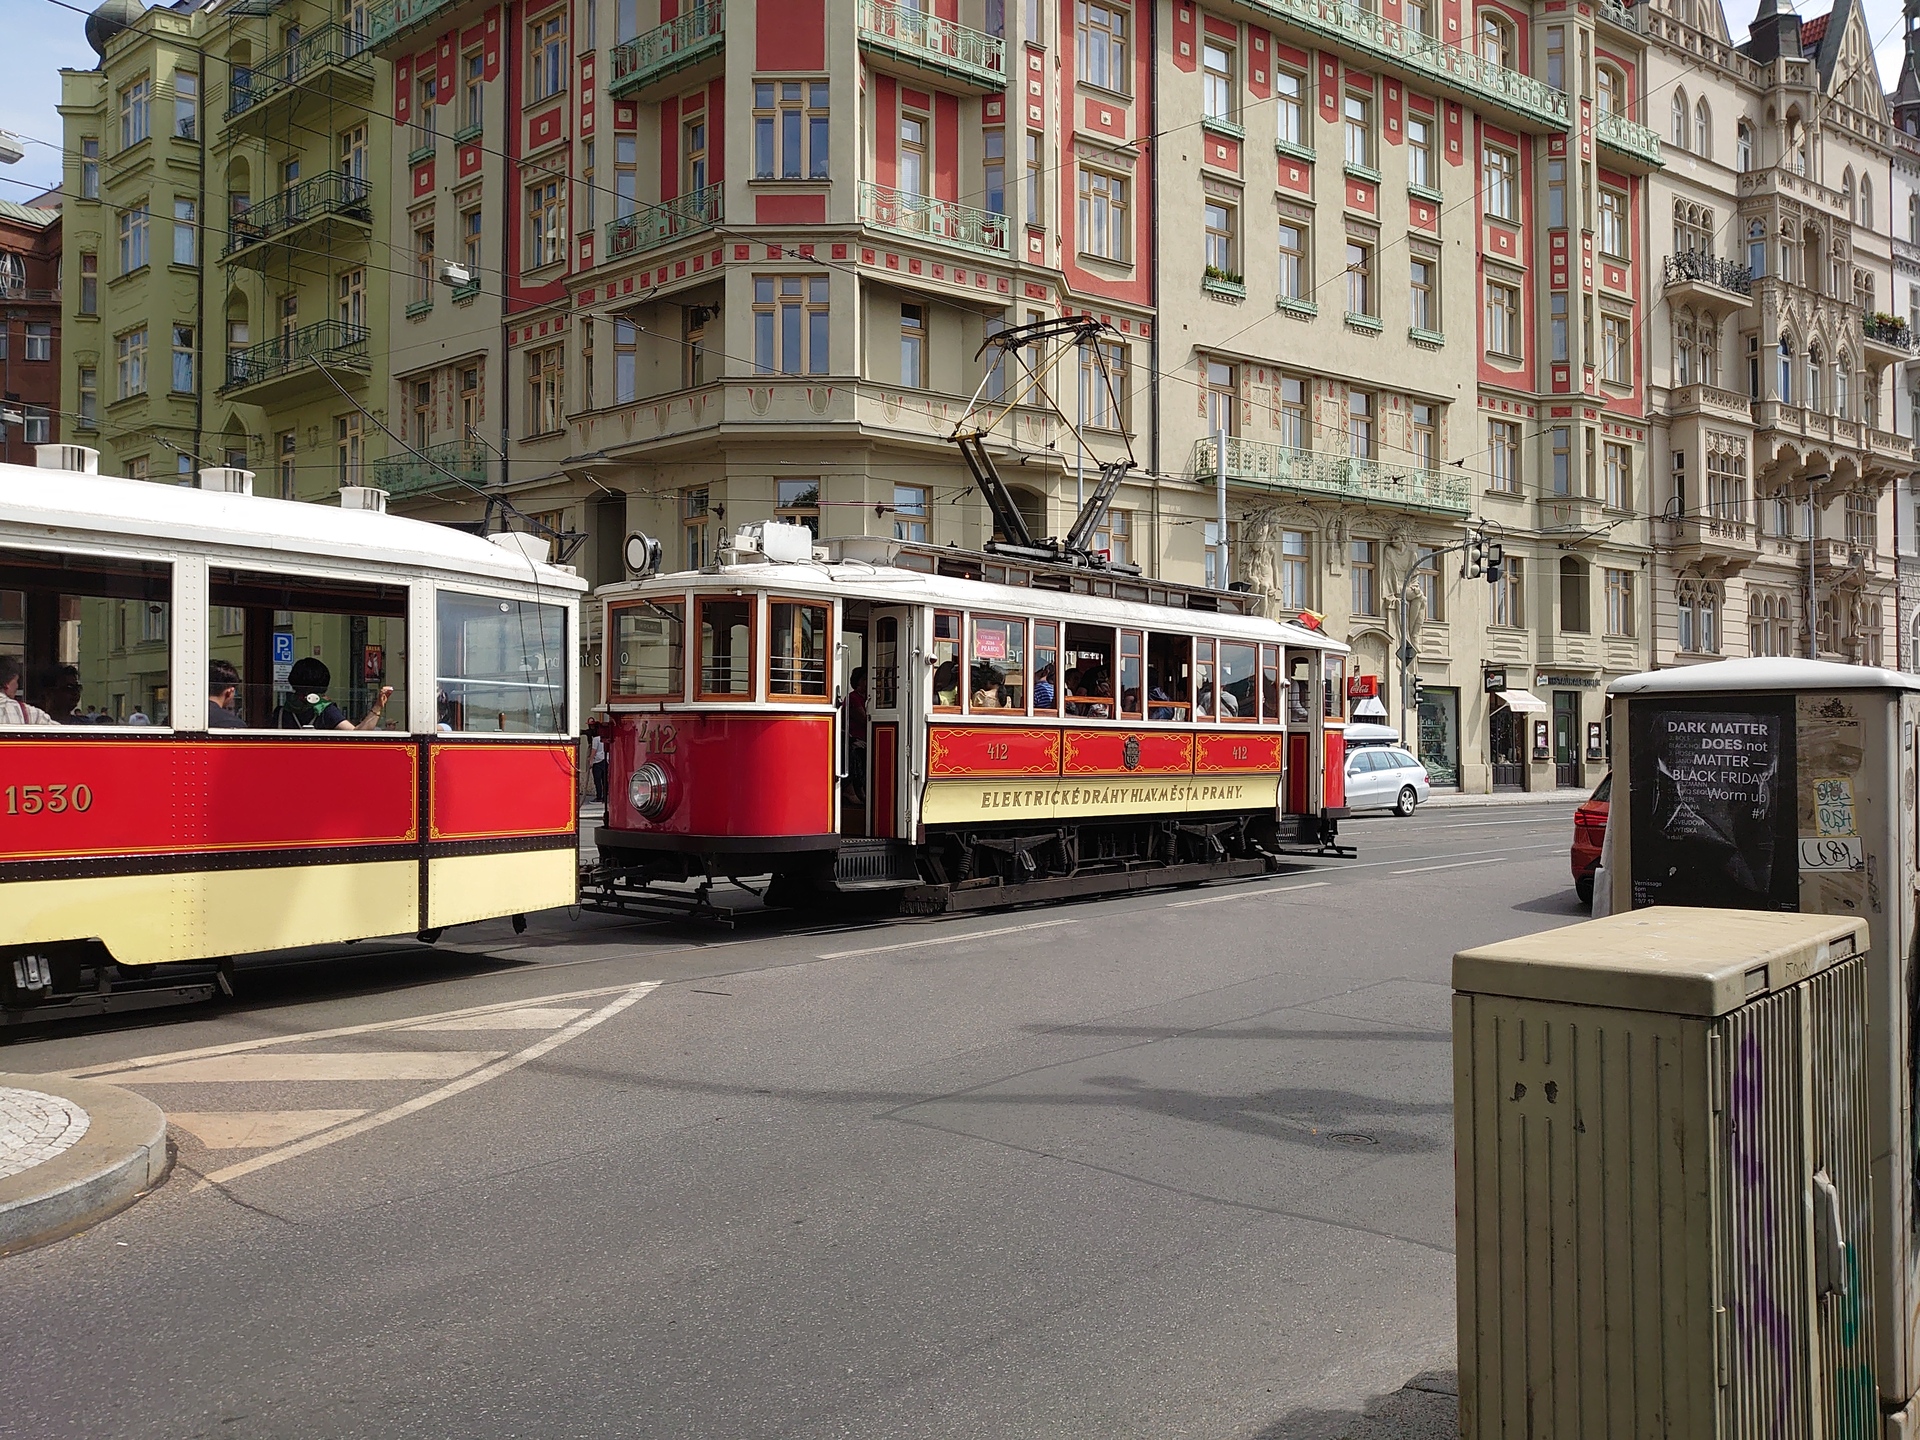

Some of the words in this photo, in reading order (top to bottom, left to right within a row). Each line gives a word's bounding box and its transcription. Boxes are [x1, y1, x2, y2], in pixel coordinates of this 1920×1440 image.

[277, 637, 289, 653] P
[1667, 721, 1707, 733] DARK
[1709, 722, 1768, 736] MATTER
[638, 723, 677, 754] 412
[1701, 738, 1743, 750] DOES
[1746, 742, 1768, 752] not
[987, 743, 1009, 760] 412
[1232, 746, 1248, 760] 412
[1693, 754, 1750, 768] MATTER
[1672, 769, 1717, 783] BLACK
[1721, 771, 1768, 785] FRIDAY
[5, 783, 93, 815] 1530
[980, 787, 1080, 808] ELEKTRICKÉ
[1081, 787, 1129, 804] DRÁHY
[1202, 785, 1243, 800] PRAHY.
[1707, 787, 1747, 801] Worm
[1751, 793, 1767, 805] up
[1751, 808, 1766, 820] #1
[1634, 880, 1663, 888] Vernissage
